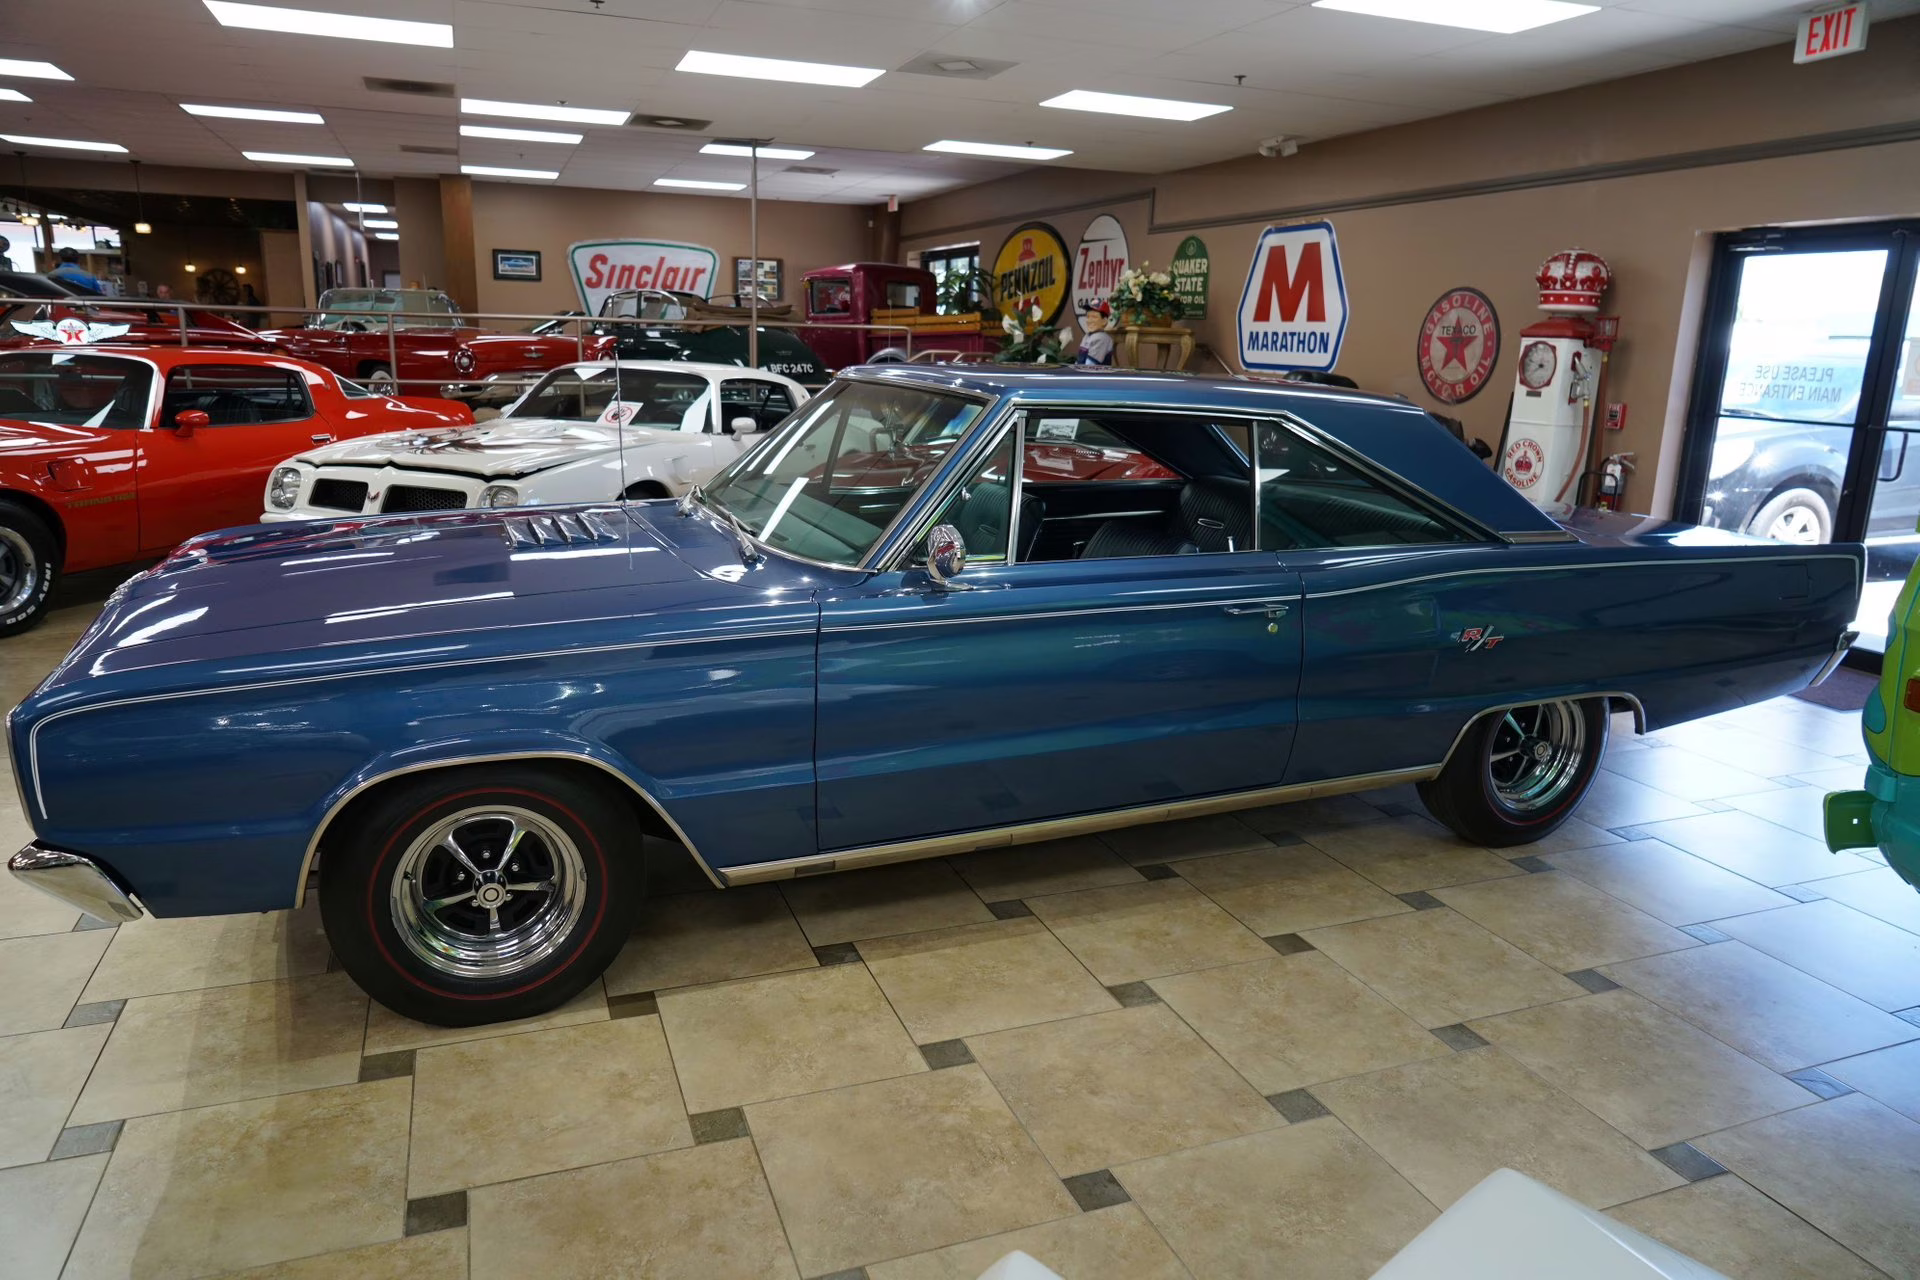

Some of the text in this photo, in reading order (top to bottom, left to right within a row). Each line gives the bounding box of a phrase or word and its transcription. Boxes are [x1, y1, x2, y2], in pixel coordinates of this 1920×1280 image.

[1805, 7, 1857, 56] EXIT
[585, 253, 706, 291] Sinclair
[1000, 254, 1056, 301] PENNZOIL
[1078, 244, 1125, 295] Zephyr
[1173, 258, 1208, 278] QUAKER
[1174, 277, 1204, 292] STATE
[1253, 241, 1327, 322] M
[1193, 294, 1205, 304] OIL
[1426, 295, 1493, 335] GASOLINE
[1247, 331, 1330, 354] MARATHON
[1441, 324, 1477, 336] TEXACO
[770, 363, 814, 374] BFC 247C
[1421, 355, 1466, 397] MOTOR
[1470, 357, 1491, 385] OIL
[1507, 442, 1521, 459] RED
[38, 562, 52, 602] INDY
[6, 605, 36, 624] 500
[1461, 625, 1504, 651] R/T
